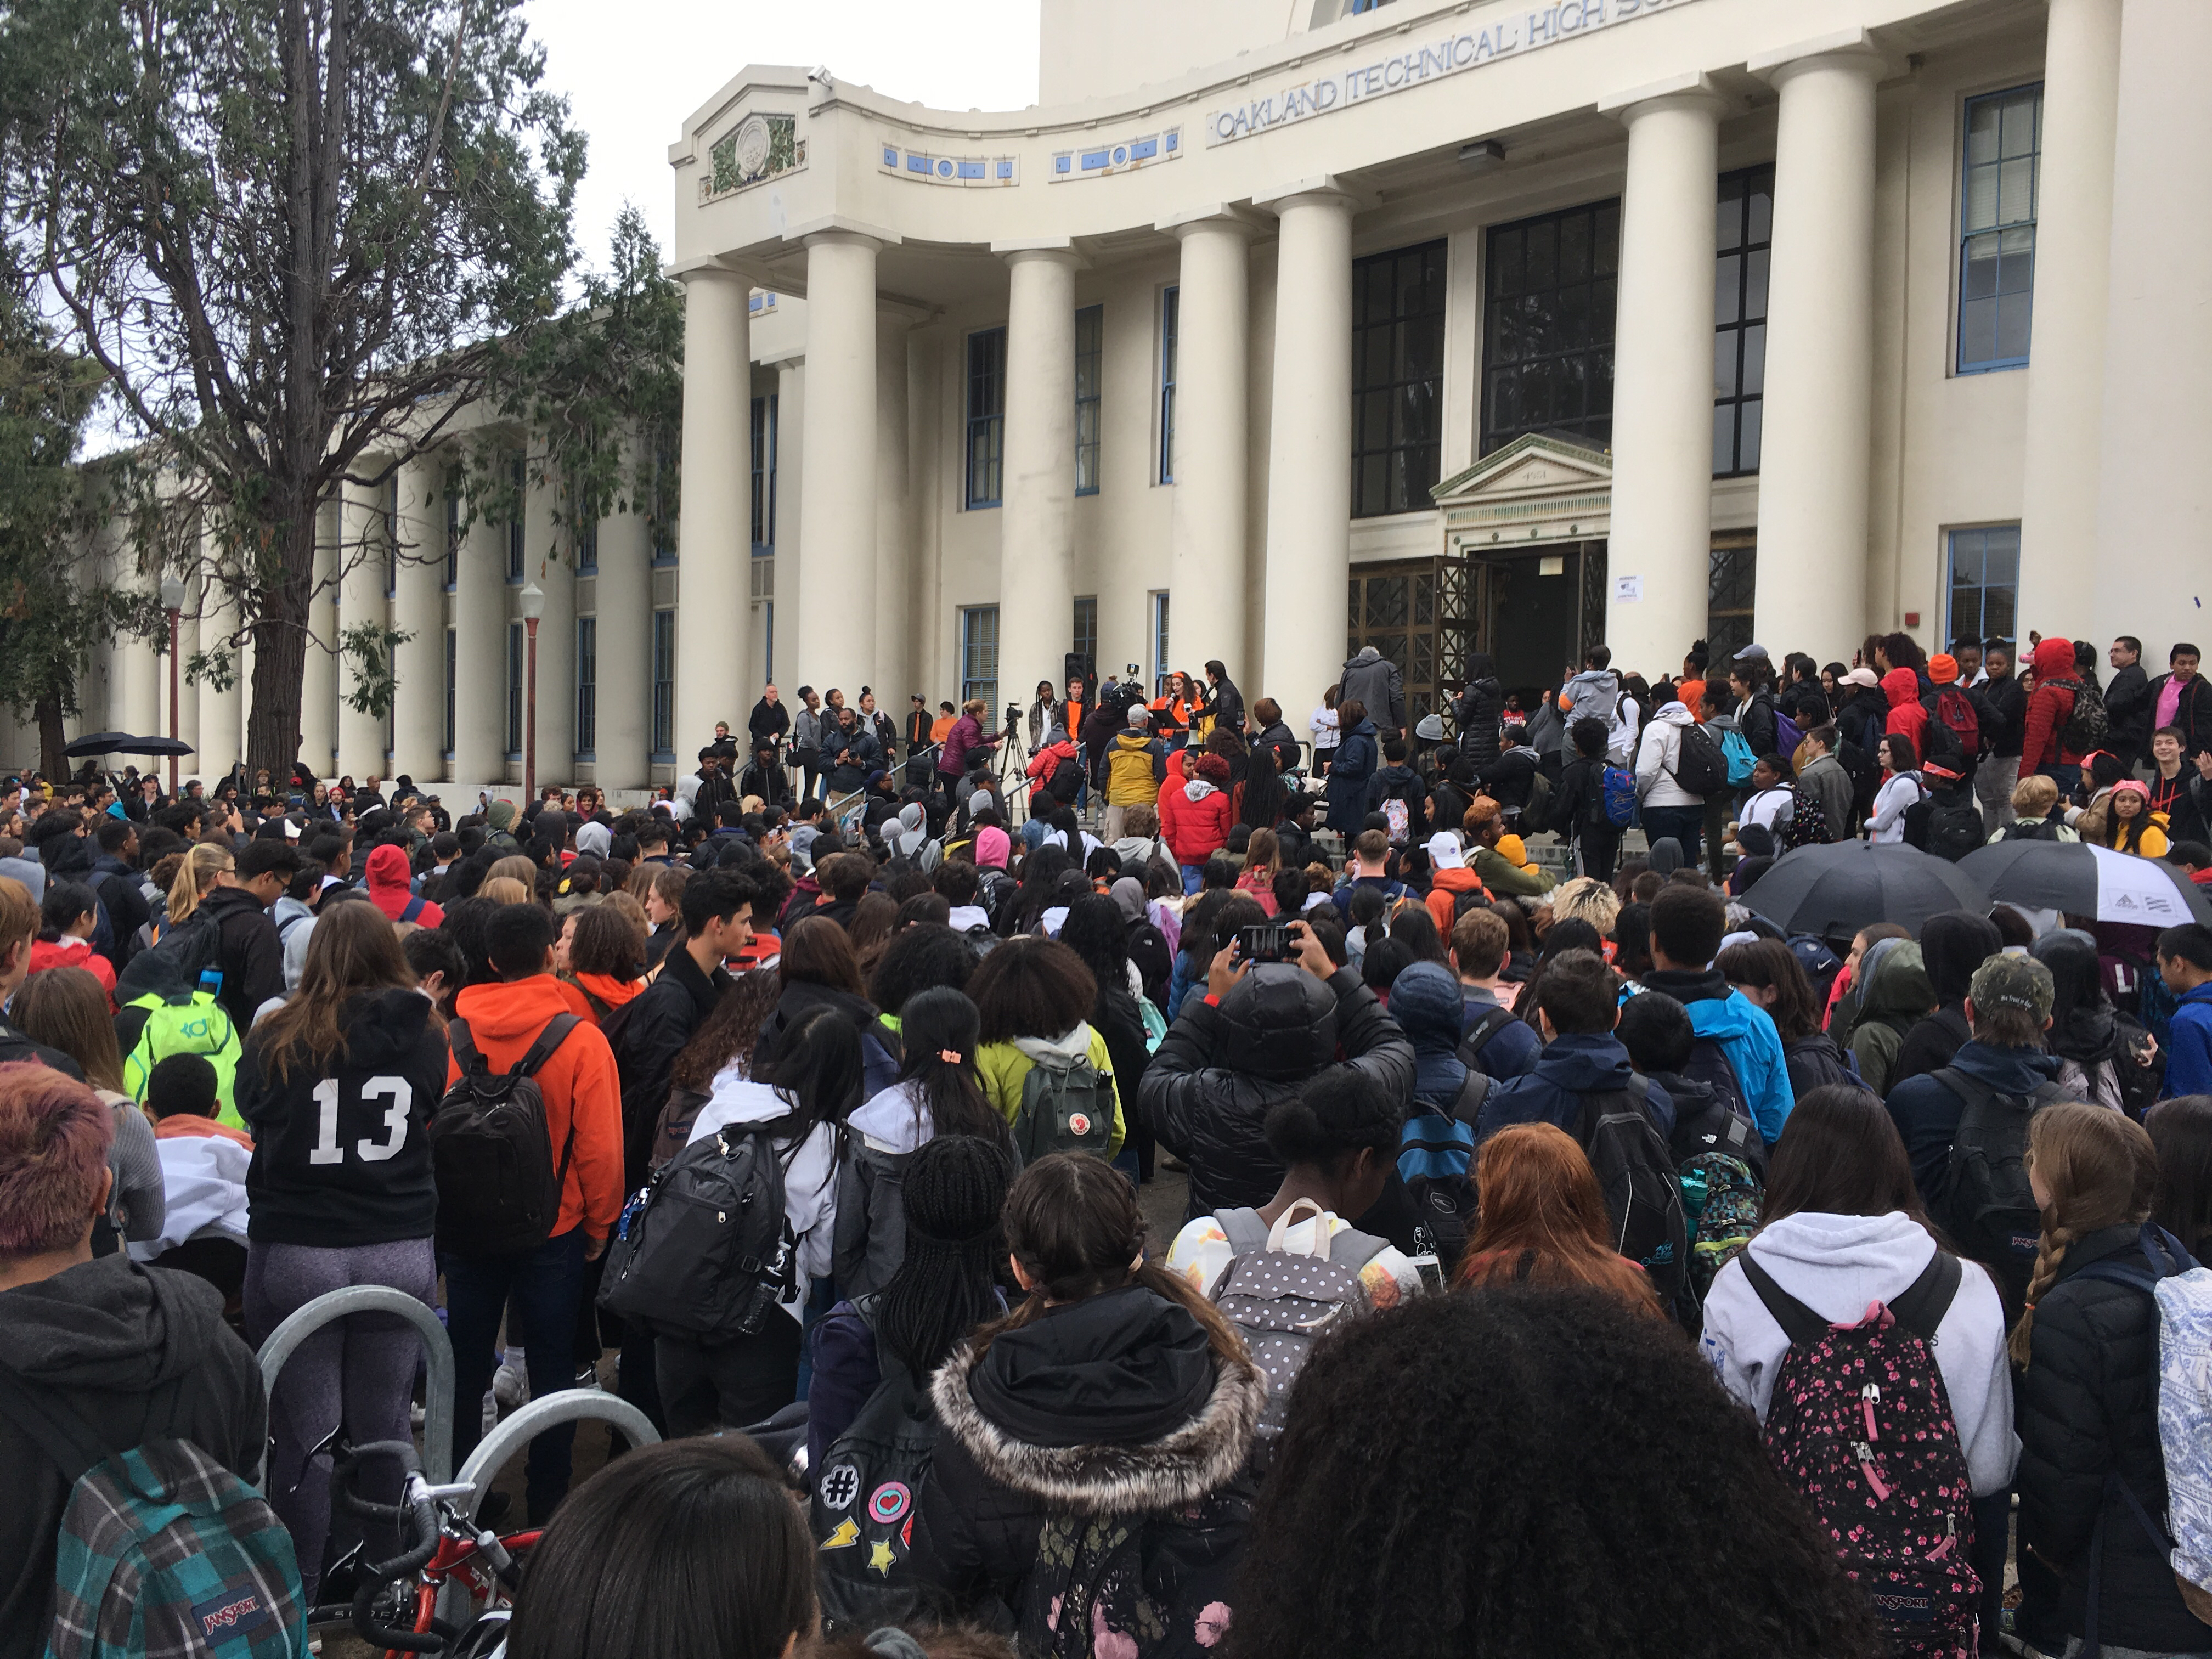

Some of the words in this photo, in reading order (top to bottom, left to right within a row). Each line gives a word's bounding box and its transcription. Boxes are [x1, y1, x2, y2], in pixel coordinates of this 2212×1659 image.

[1217, 81, 1338, 138] OAKLAND
[1347, 25, 1517, 98] TECHNICAL
[1528, 0, 1606, 45] HIGH
[310, 1076, 413, 1164] 13
[203, 1596, 261, 1635] JANSPORT
[1874, 1594, 1928, 1610] NSPORT
